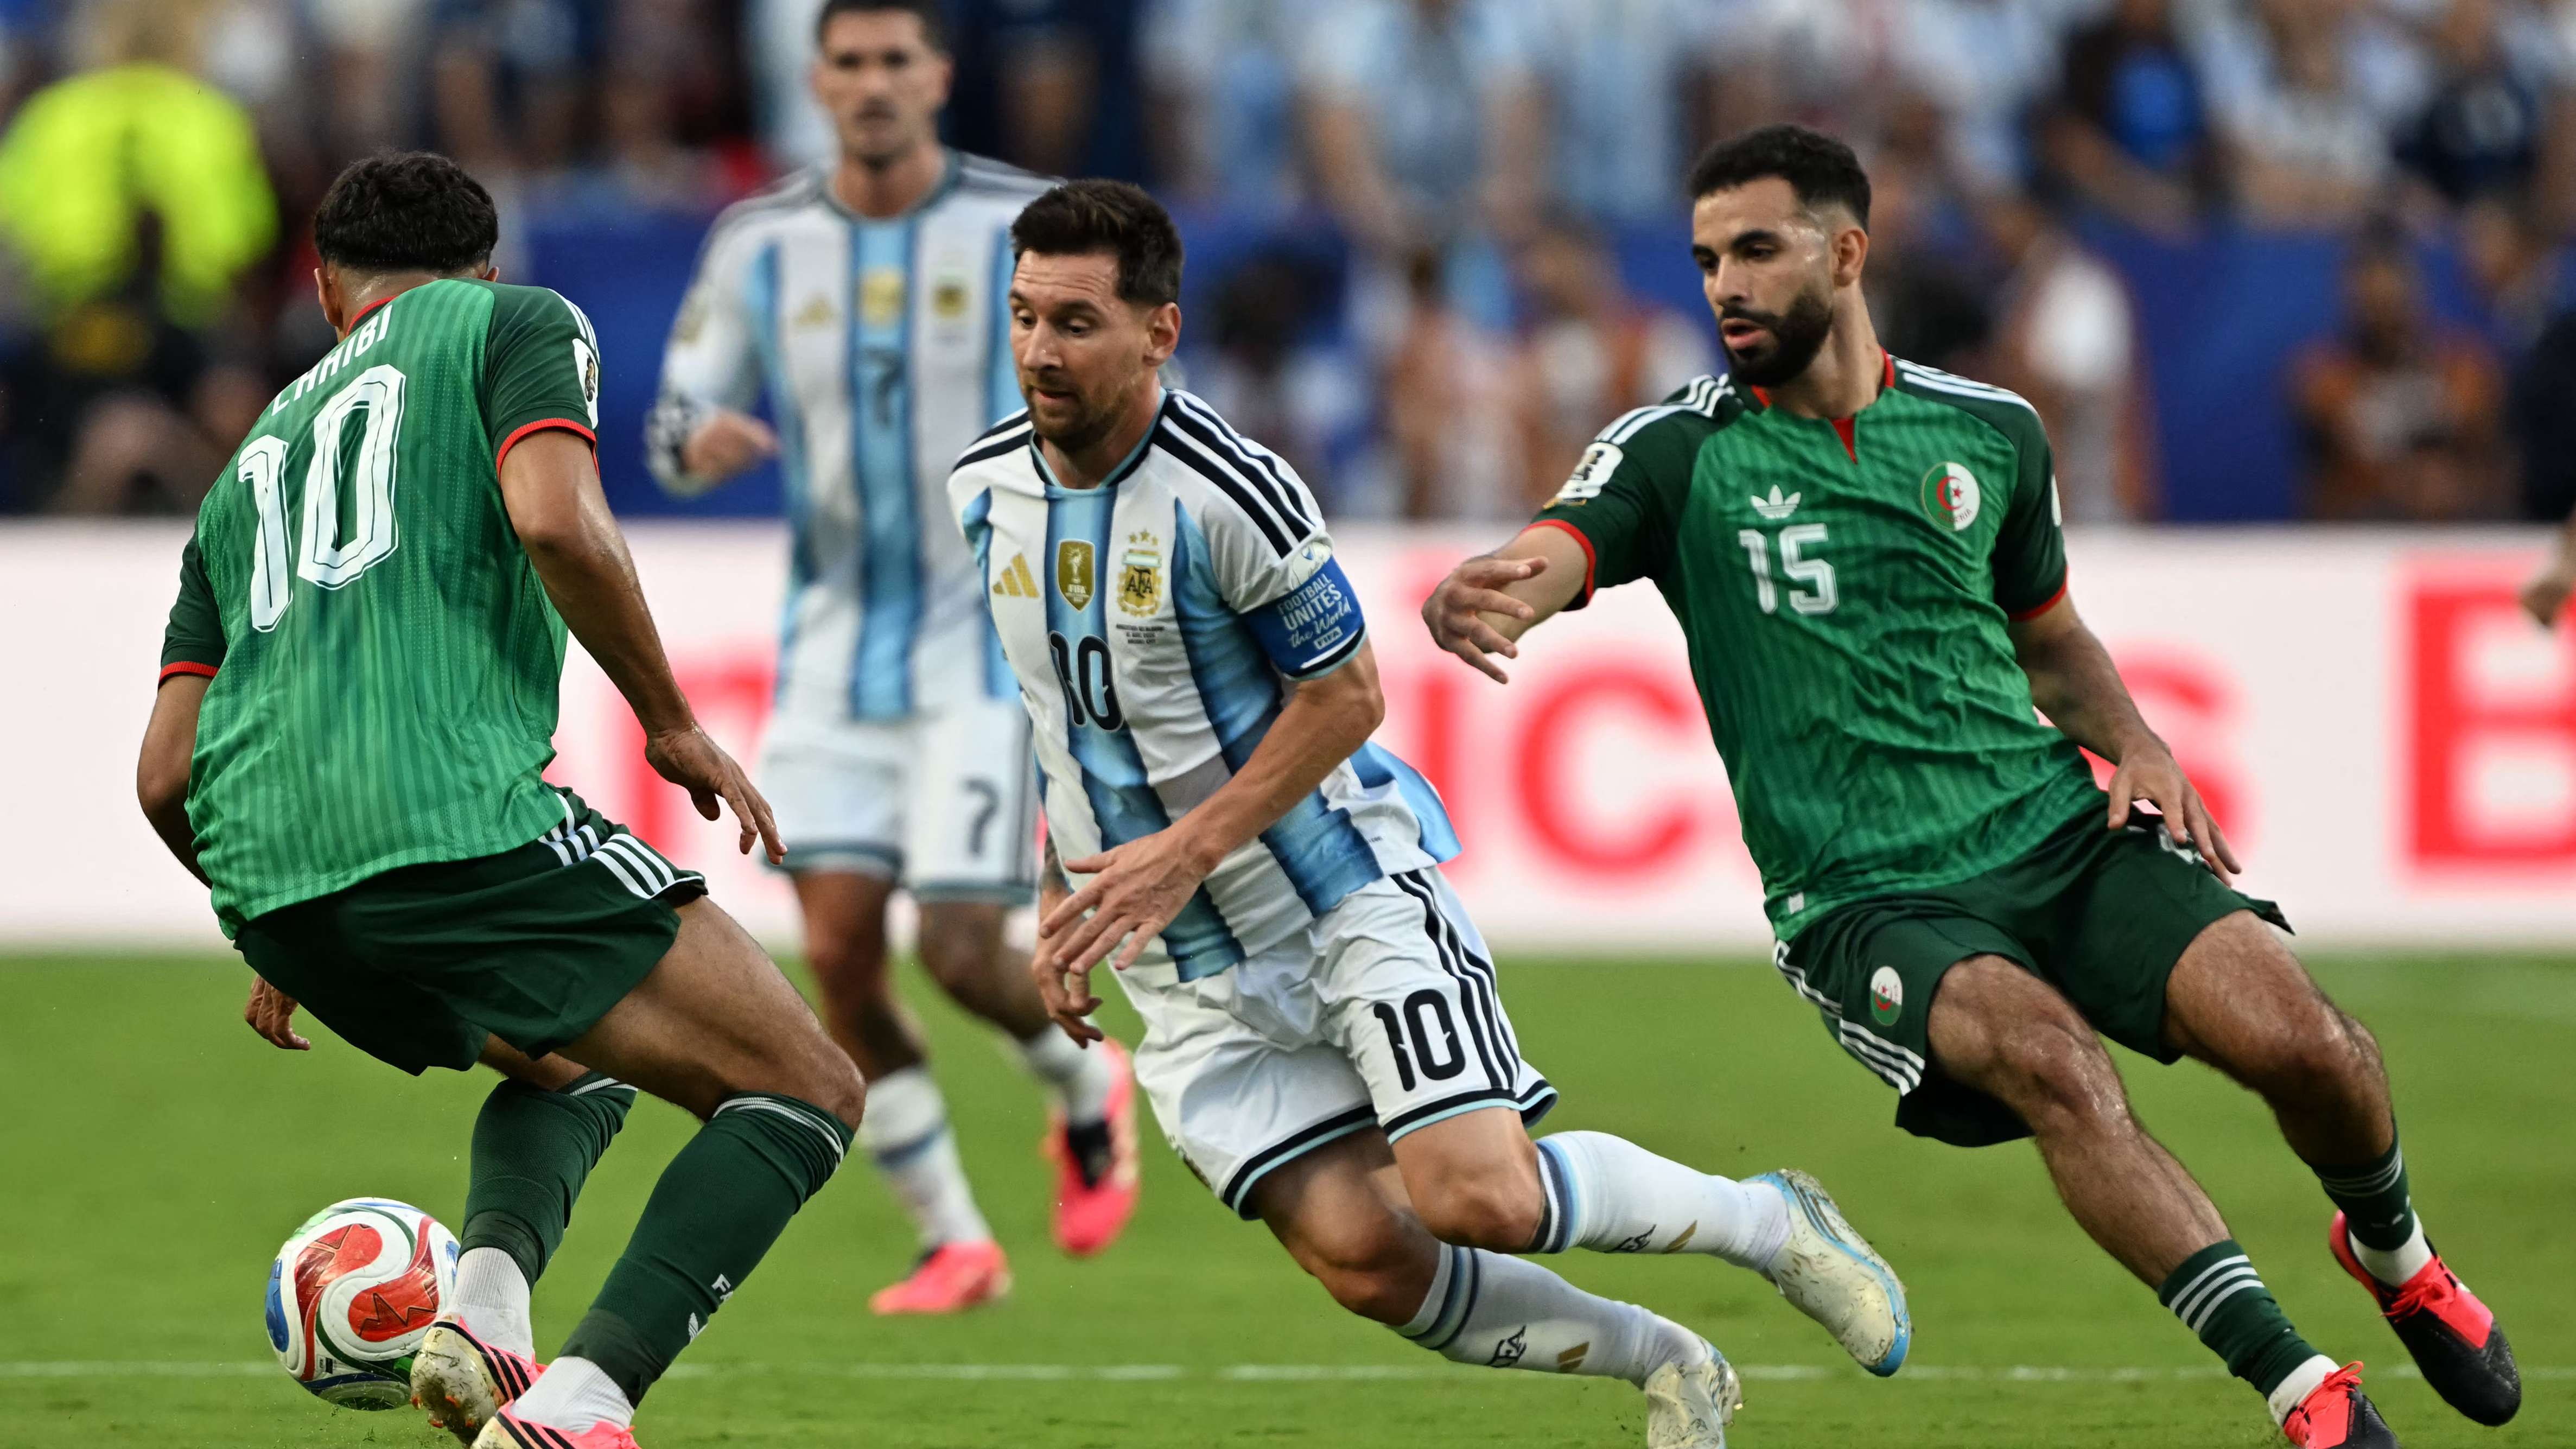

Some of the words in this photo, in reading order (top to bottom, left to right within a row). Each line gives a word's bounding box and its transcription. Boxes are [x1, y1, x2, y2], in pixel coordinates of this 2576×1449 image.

[237, 363, 406, 633] 10
[1126, 567, 1153, 599] AFA
[1277, 573, 1332, 615] FOOTBALL
[1282, 583, 1342, 631] UNITES
[1739, 523, 1839, 615] 15
[1288, 630, 1313, 649] the
[1314, 596, 1352, 634] World
[1049, 631, 1124, 732] 10
[961, 776, 1000, 858] 7
[1373, 989, 1466, 1092] 10
